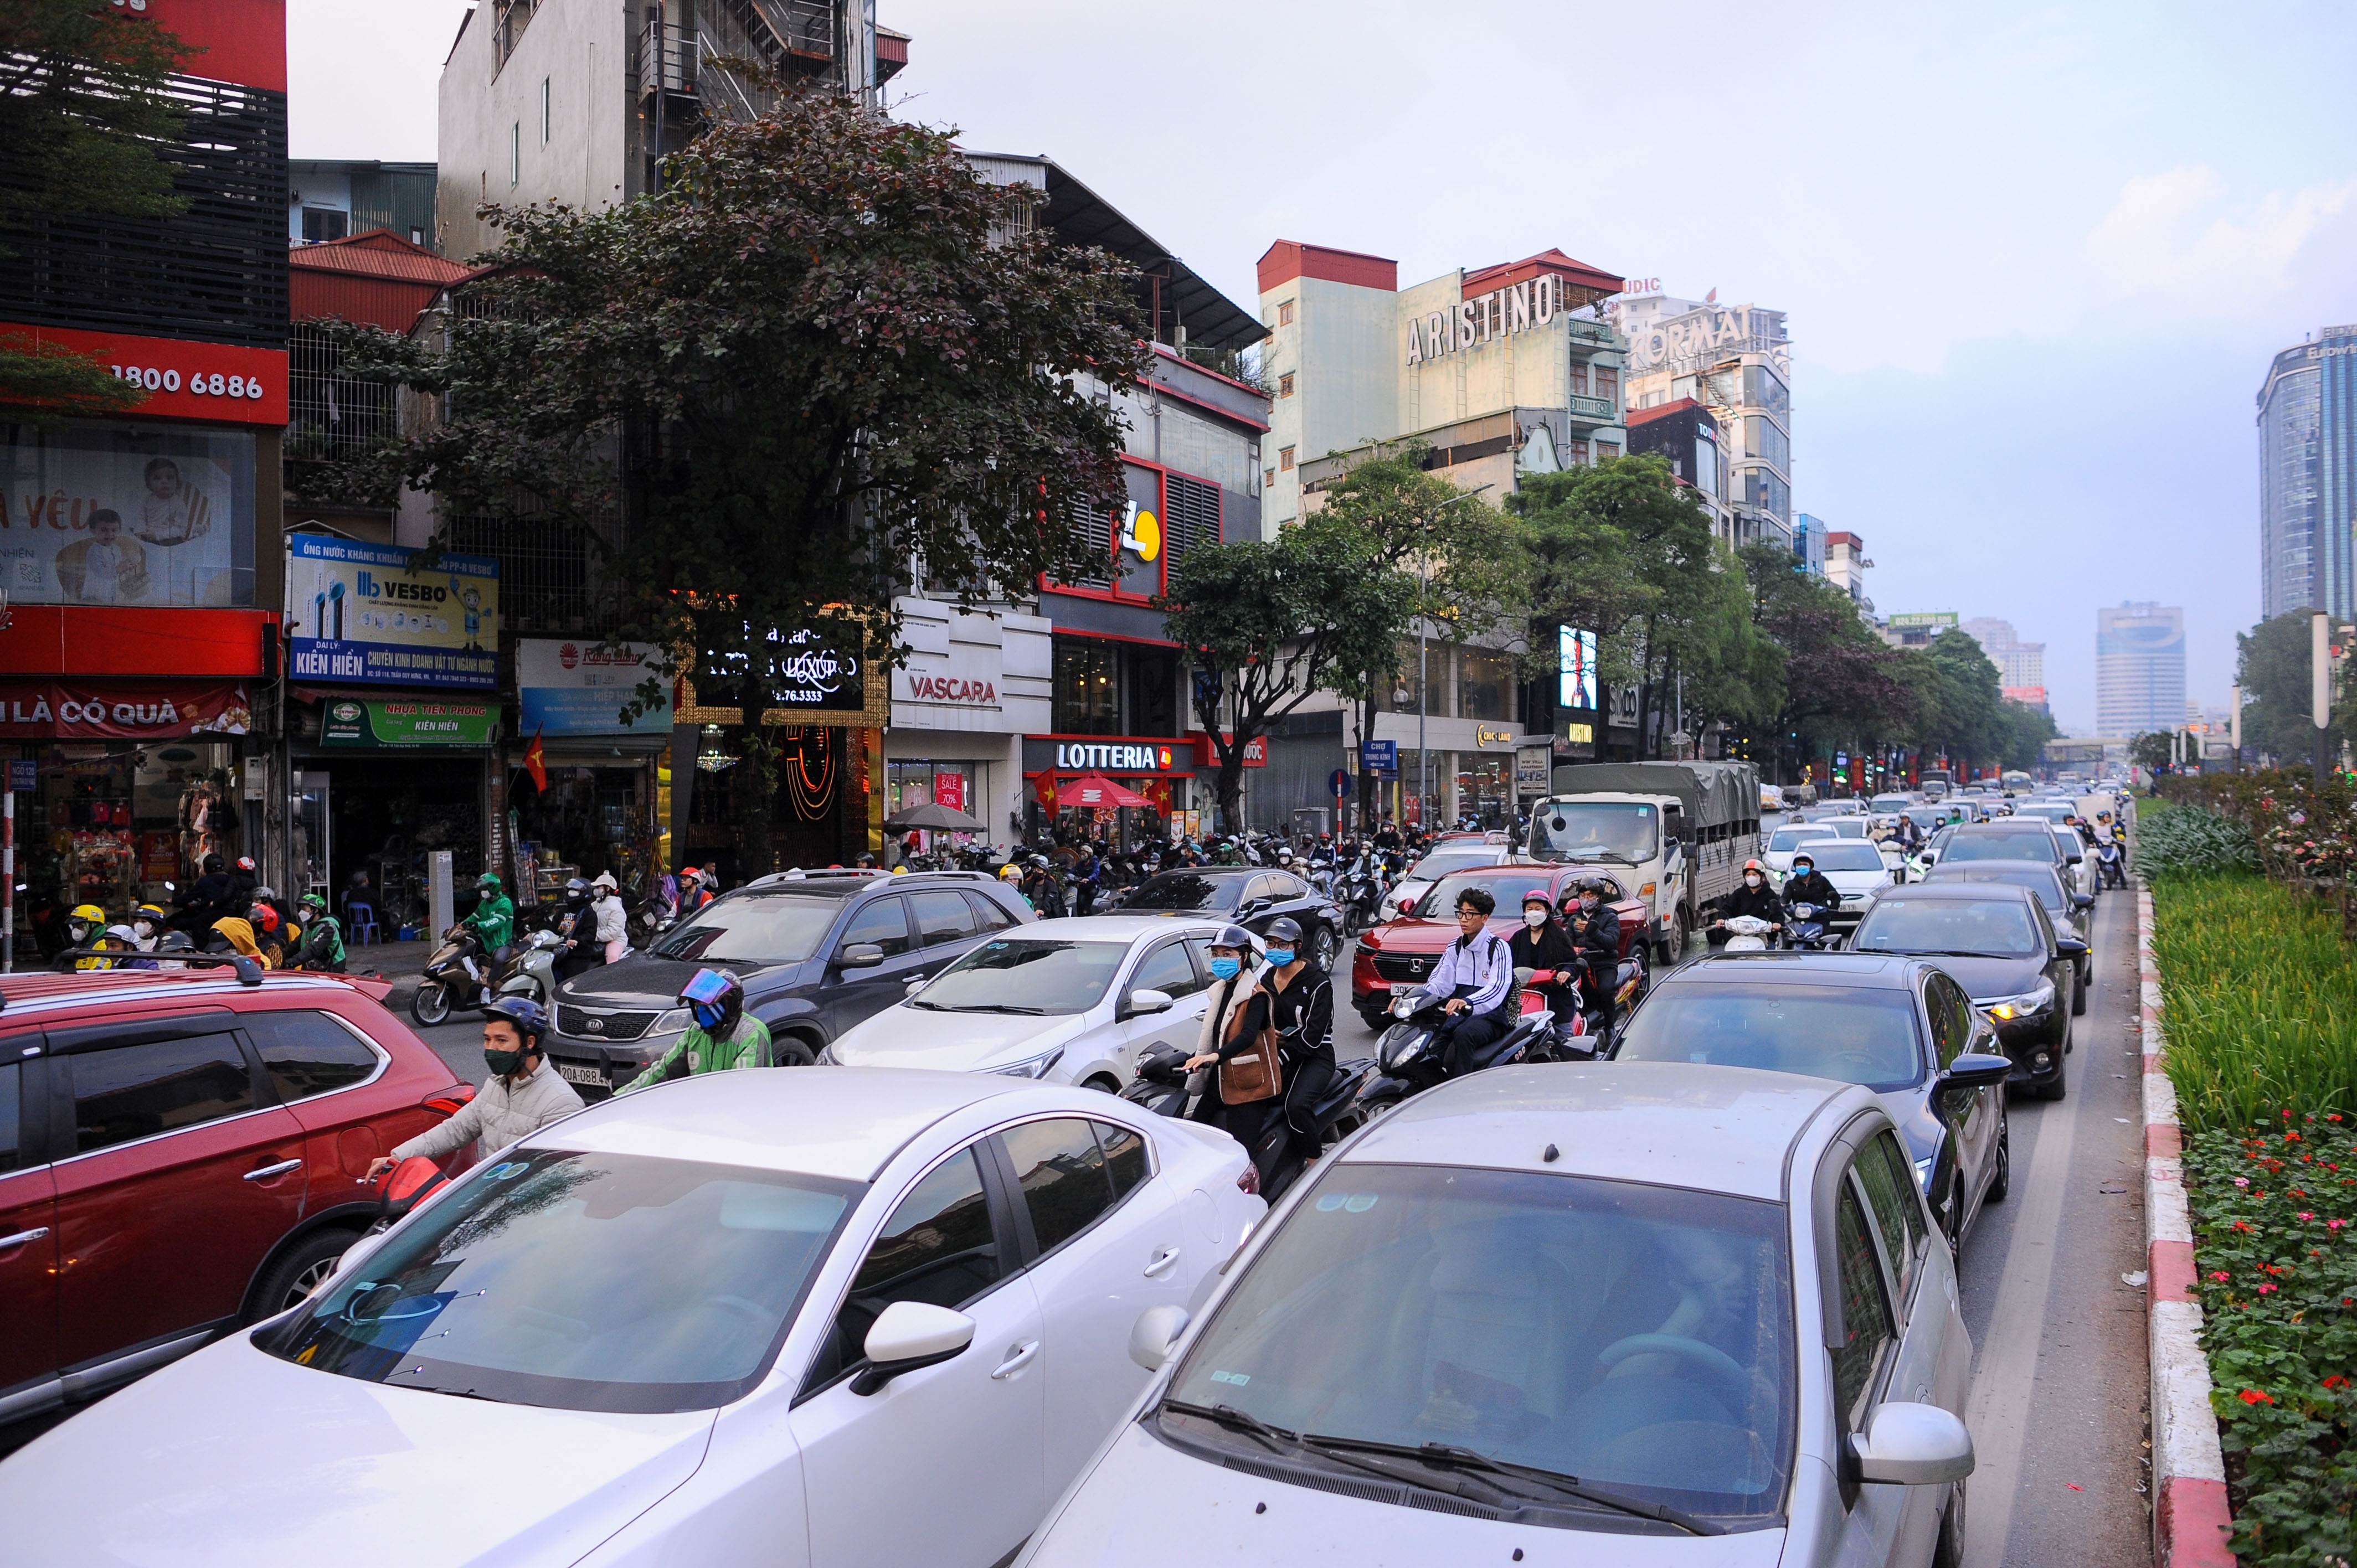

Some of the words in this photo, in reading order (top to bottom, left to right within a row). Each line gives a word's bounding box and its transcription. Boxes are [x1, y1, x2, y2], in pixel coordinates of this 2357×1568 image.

[1622, 277, 1661, 294] UDIC
[1406, 274, 1555, 365] ARISTINO
[1630, 303, 1753, 369] FORMAT
[111, 365, 181, 391] 1800
[191, 372, 263, 398] 6886
[303, 541, 321, 555] ỐNG
[323, 545, 345, 558] NƯỚC
[348, 549, 374, 561] KHÁNG
[384, 581, 446, 602] VESBO
[316, 641, 328, 651] ĐẠI
[296, 649, 328, 674] KIÊN
[332, 648, 363, 676] HIỀN
[368, 649, 393, 667] CHUYÊN
[395, 653, 410, 668] KINH
[412, 654, 433, 669] DOANH
[435, 653, 446, 673] VẬT
[447, 655, 456, 670] TƯ
[456, 654, 477, 672] NGÀNH
[478, 656, 495, 673] NƯỚC
[910, 676, 996, 703] VASCARA
[13, 695, 53, 723] LÀ
[60, 697, 105, 723] CÓ
[112, 699, 179, 726] QUÀ
[450, 706, 486, 716] PHONG
[415, 720, 435, 731] KIÊN
[1569, 723, 1592, 743] ARISTINO
[1371, 742, 1386, 751] CHỢ
[1498, 732, 1511, 741] LAND
[1056, 744, 1155, 768] LOTTERIA
[25, 767, 35, 775] 120
[941, 780, 957, 789] SALE
[588, 1022, 599, 1030] KIA
